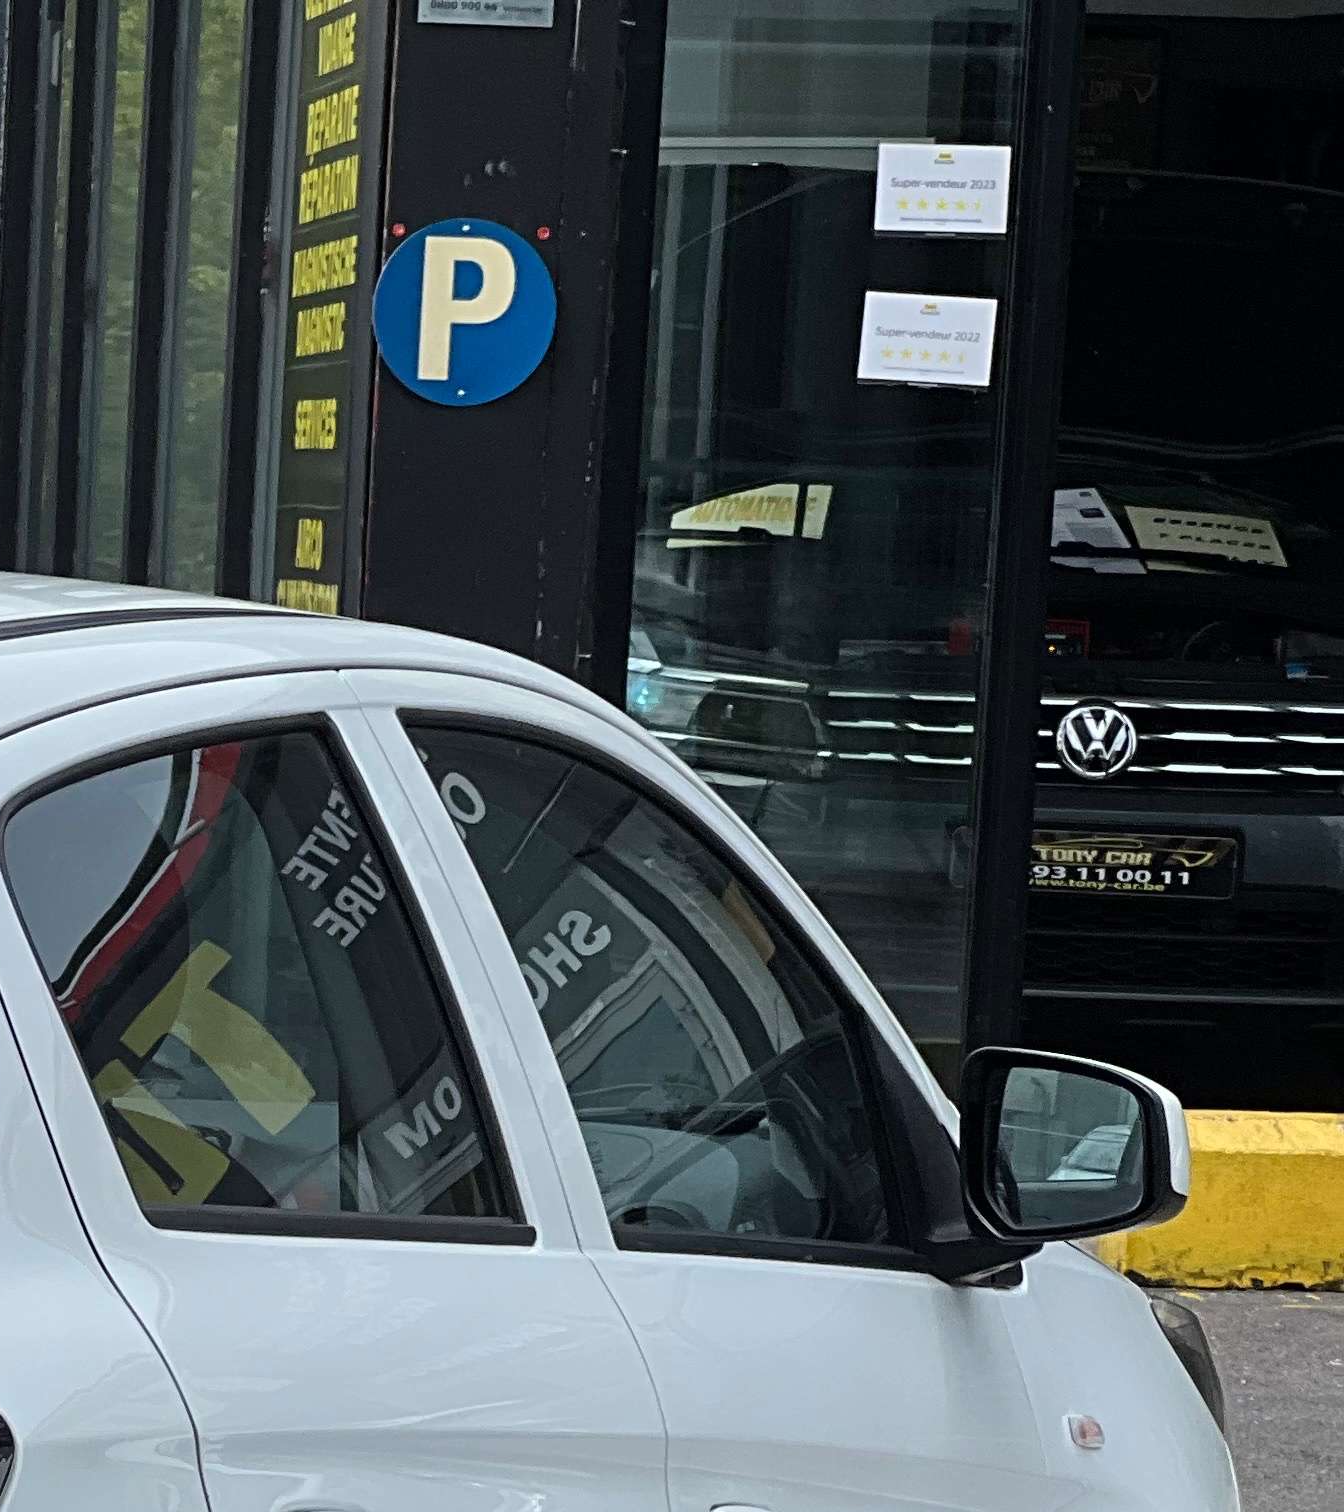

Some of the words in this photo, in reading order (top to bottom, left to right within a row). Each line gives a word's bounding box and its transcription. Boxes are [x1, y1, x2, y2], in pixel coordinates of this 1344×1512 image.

[305, 84, 360, 157] REPARATIE
[890, 177, 967, 189] Super-vendeur
[969, 178, 997, 190] 2023
[418, 235, 517, 381] P
[874, 325, 952, 341] Super-vendeur
[954, 330, 981, 343] 2022
[1153, 516, 1264, 534] ESSENCE
[1178, 534, 1271, 550] PLACES
[1034, 847, 1098, 864] TONY
[1104, 851, 1153, 867] CAR
[1029, 865, 1067, 880] 93
[1076, 866, 1107, 881] 11
[1115, 869, 1152, 884] 00
[1159, 871, 1190, 885] 11
[1028, 878, 1176, 892] ww.tony-car.be
